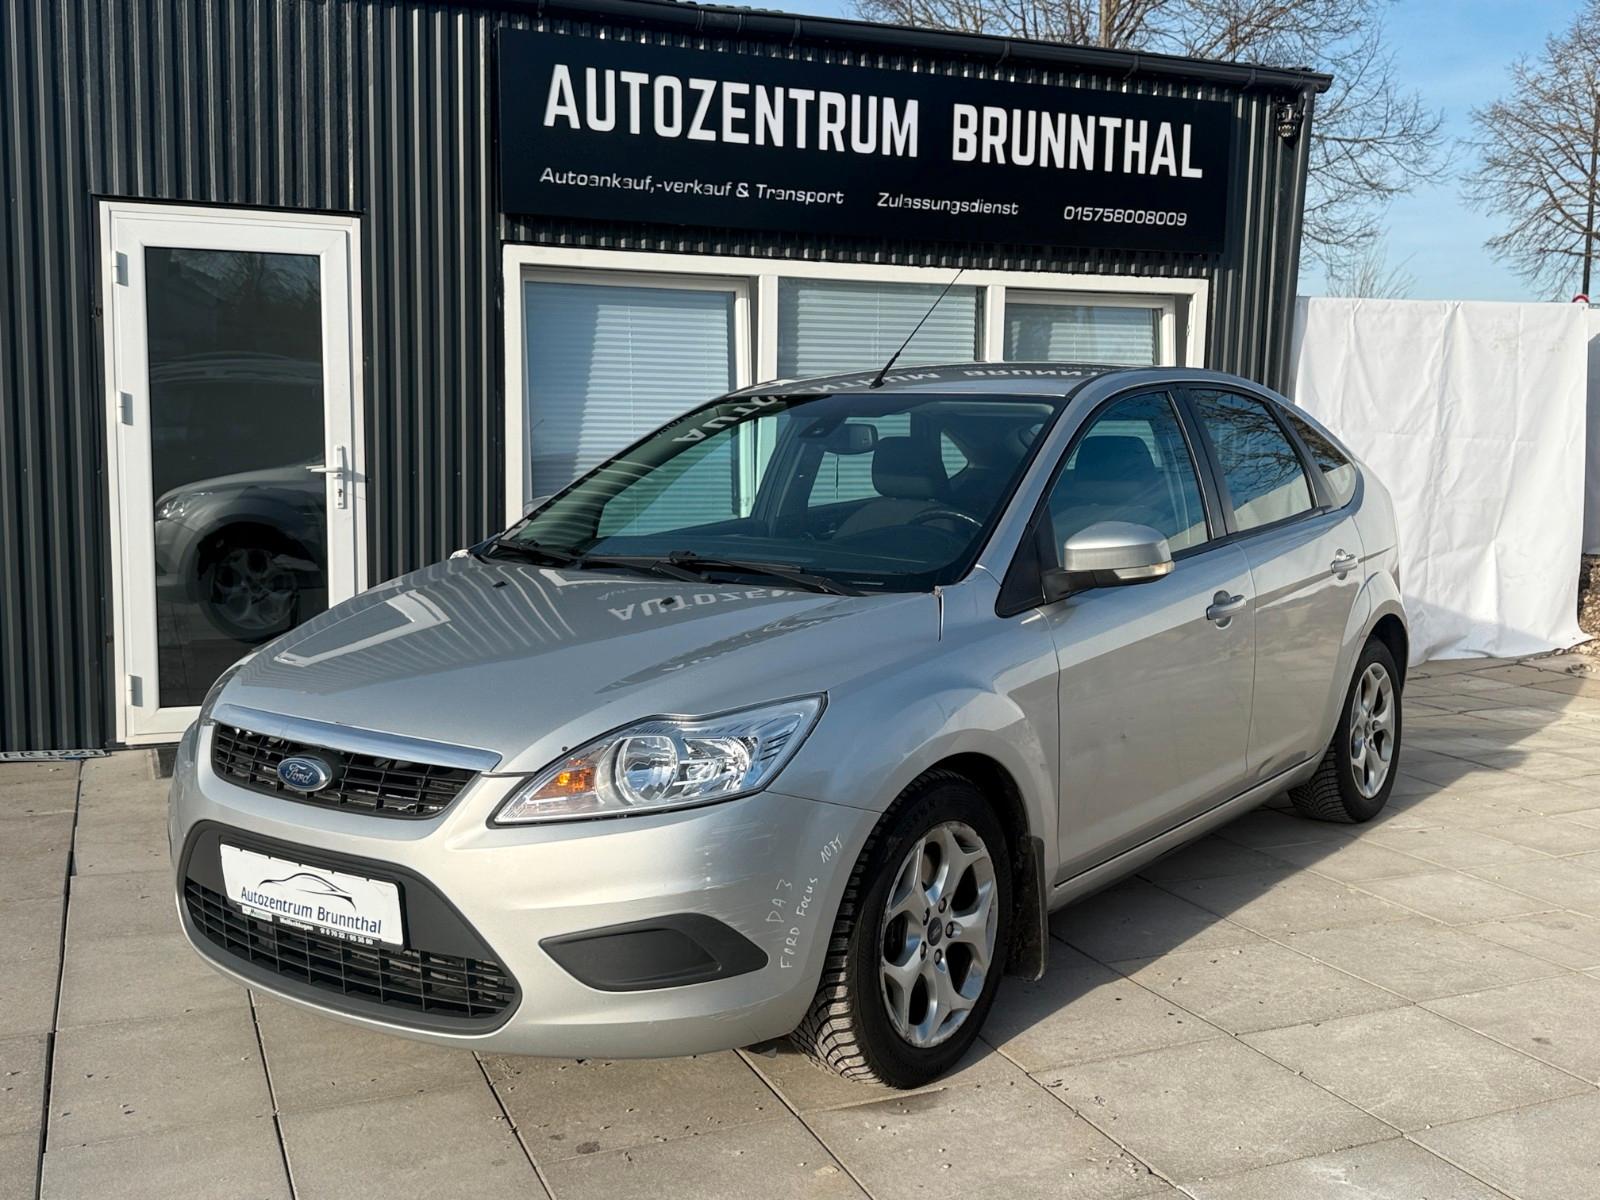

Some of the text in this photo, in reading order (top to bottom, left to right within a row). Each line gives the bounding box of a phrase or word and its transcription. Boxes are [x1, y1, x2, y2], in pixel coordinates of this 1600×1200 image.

[543, 64, 1203, 179] AUTOZENTRUM BRUNNTHAL
[736, 182, 750, 198] &
[756, 184, 845, 206] Transport
[877, 192, 1019, 216] Zulassungsdienst
[1063, 205, 1187, 227] 015758008009
[286, 763, 313, 784] Ford
[241, 886, 312, 918] Autozentrum
[317, 906, 382, 934] Brunnthal
